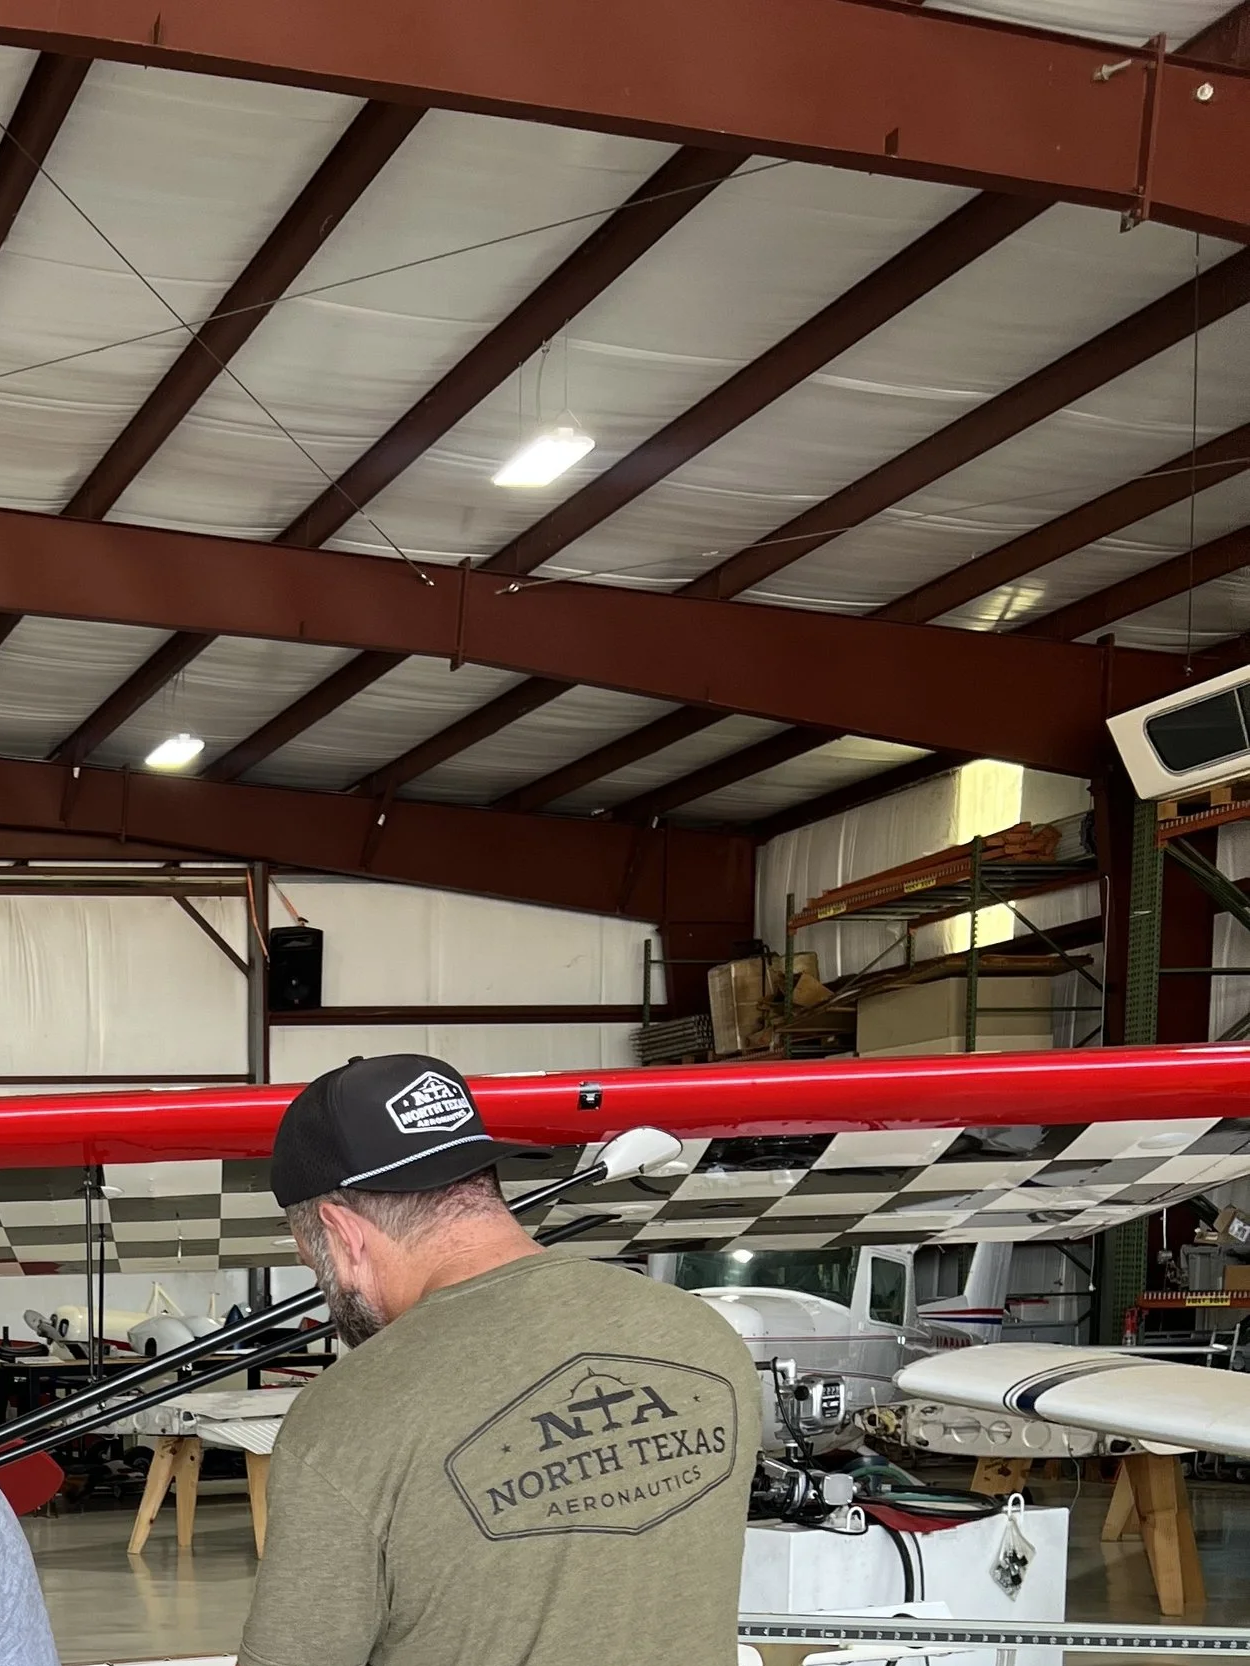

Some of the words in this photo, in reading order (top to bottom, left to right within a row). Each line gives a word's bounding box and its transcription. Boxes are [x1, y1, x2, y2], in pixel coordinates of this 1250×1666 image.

[399, 1101, 445, 1125] NORTH
[530, 1385, 679, 1451] NTA
[486, 1444, 624, 1515] NORTH
[628, 1426, 726, 1466] TEXAS
[546, 1465, 701, 1517] AERONAUTICS
